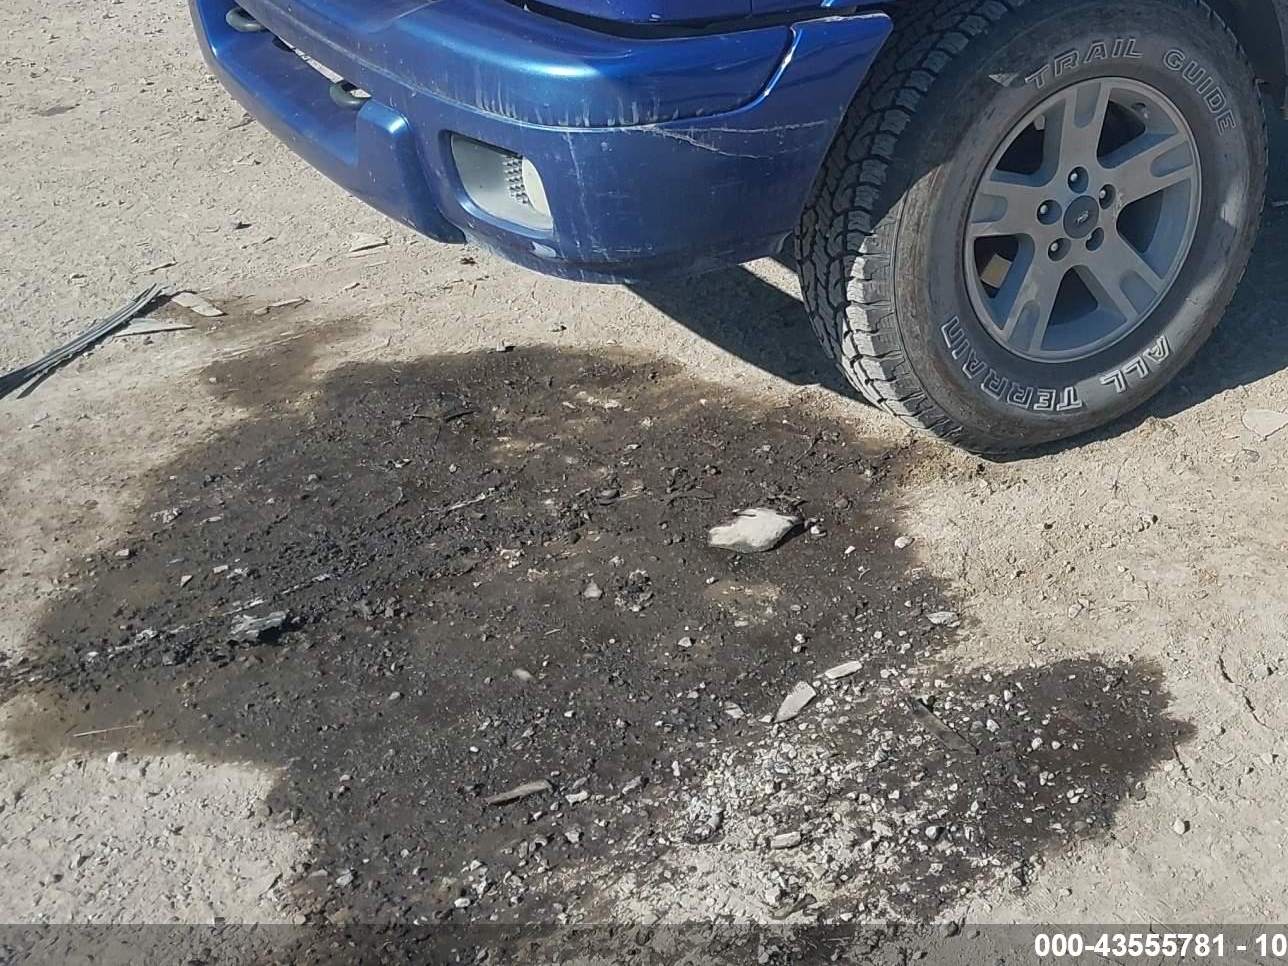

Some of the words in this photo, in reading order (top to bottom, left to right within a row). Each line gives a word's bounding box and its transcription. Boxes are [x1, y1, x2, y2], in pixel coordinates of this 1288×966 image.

[1024, 37, 1144, 89] TRAIL
[1162, 48, 1237, 136] GUIDE
[940, 314, 1084, 411] TERRAIN
[1100, 335, 1171, 394] ALL
